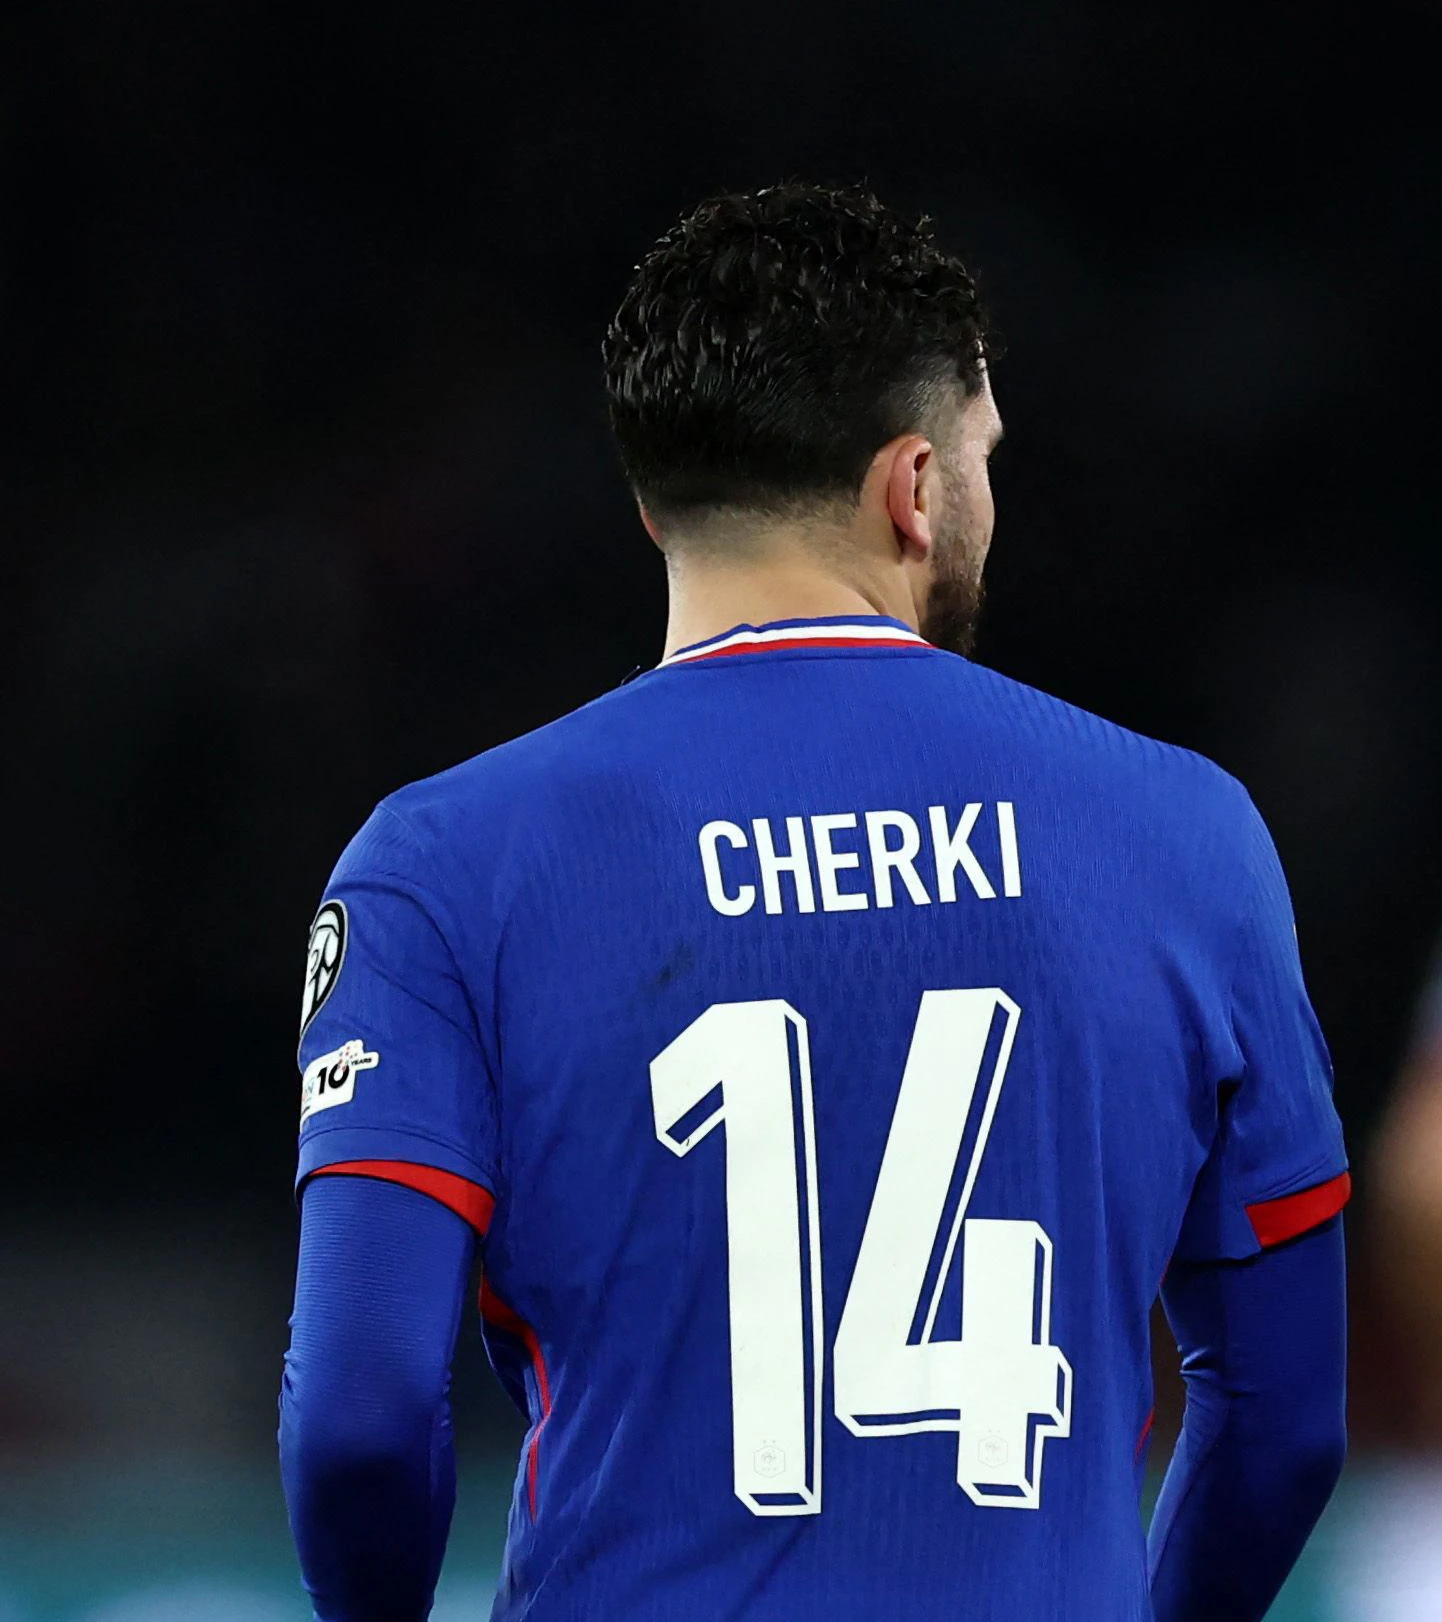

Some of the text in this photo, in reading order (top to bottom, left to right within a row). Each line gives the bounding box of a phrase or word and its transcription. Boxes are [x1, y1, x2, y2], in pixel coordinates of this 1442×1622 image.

[698, 801, 1022, 916] CHERKI
[316, 1063, 350, 1095] 10
[649, 987, 1073, 1516] 14
